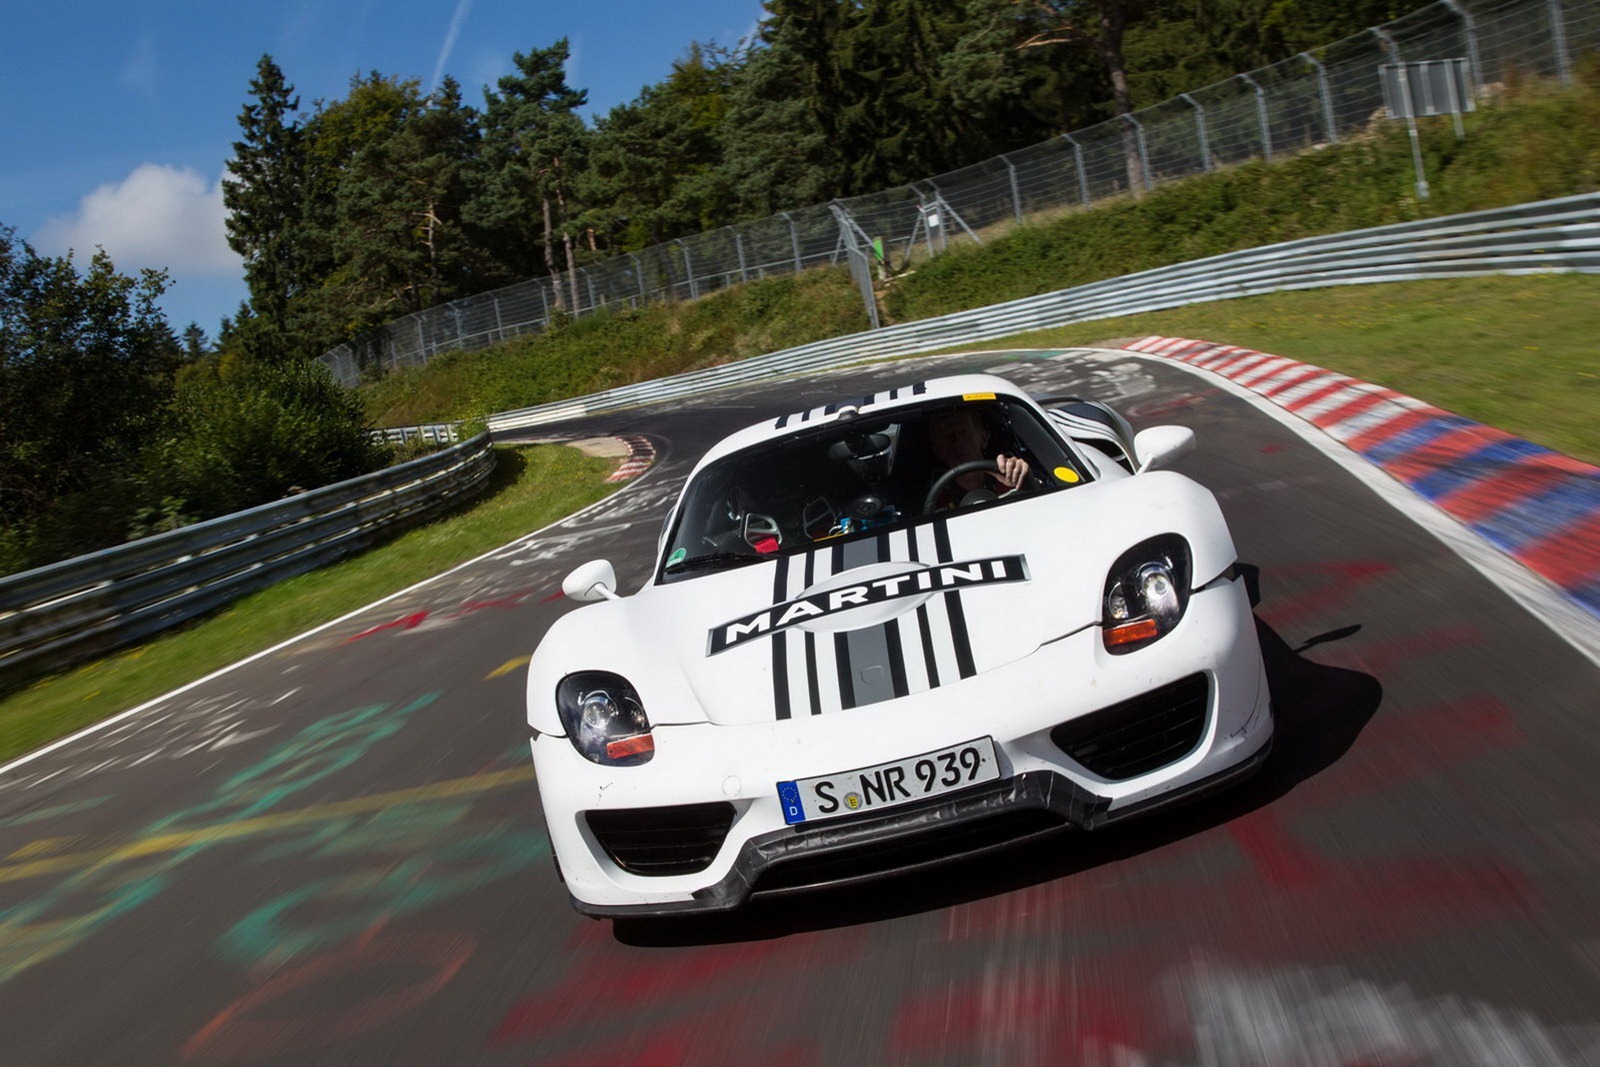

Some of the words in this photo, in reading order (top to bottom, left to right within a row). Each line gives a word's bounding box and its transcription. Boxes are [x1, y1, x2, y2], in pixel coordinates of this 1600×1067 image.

[726, 560, 1007, 645] MARTINI
[789, 806, 799, 816] D
[815, 781, 839, 813] S
[860, 766, 911, 805] NR
[915, 747, 981, 792] 939
